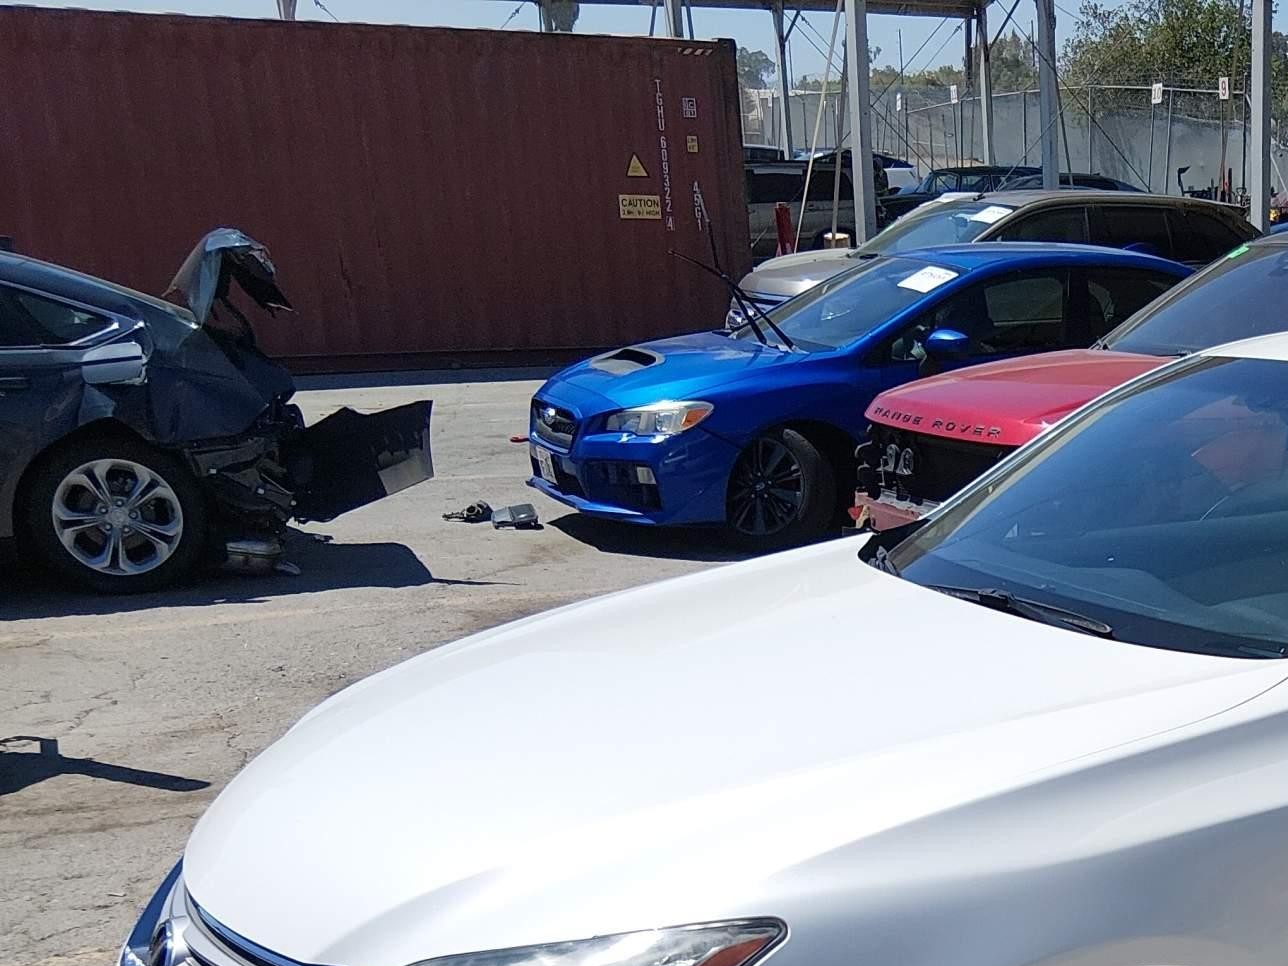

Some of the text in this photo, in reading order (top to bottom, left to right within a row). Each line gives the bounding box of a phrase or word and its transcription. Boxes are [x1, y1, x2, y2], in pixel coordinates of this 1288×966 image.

[1221, 80, 1227, 96] 9
[654, 79, 665, 131] TGHU
[660, 135, 673, 212] 609322
[621, 198, 659, 208] CAUTION
[874, 407, 1002, 438] RANGE ROVER
